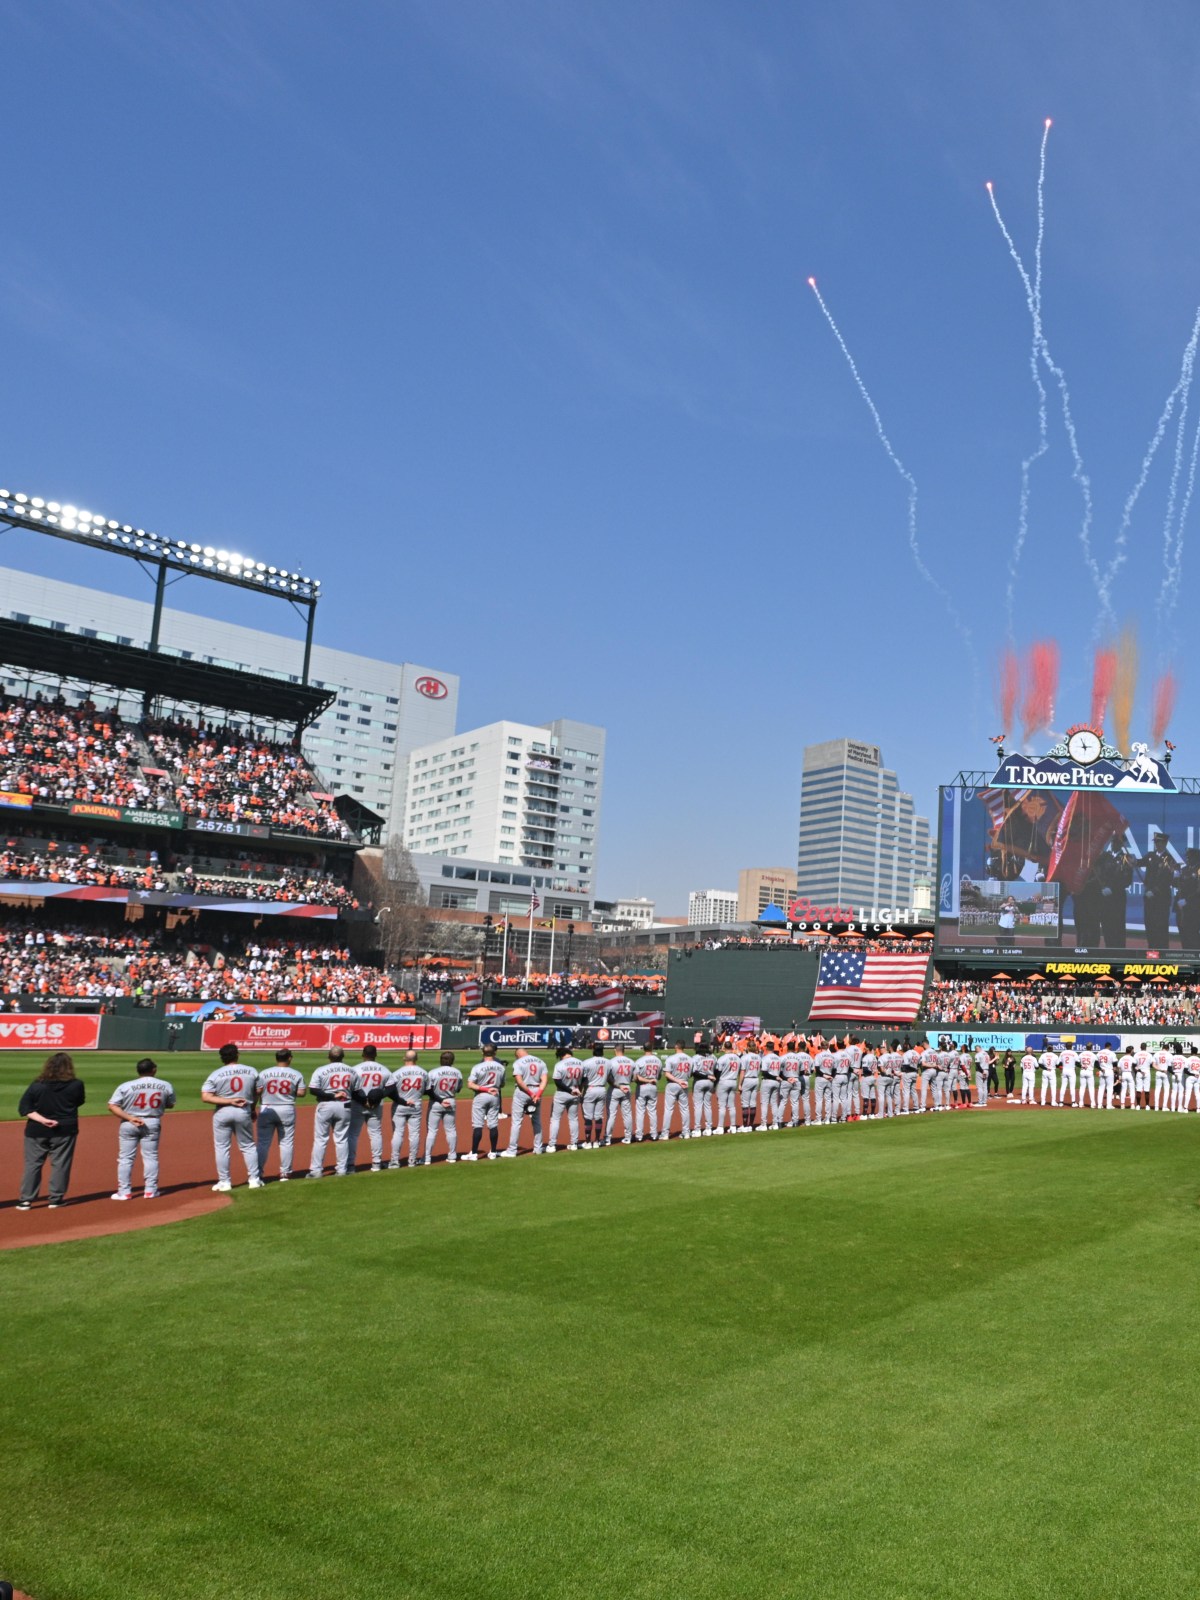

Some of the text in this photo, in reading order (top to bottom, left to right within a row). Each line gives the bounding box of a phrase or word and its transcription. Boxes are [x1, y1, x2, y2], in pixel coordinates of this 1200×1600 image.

[1071, 768, 1114, 786] Price
[74, 803, 119, 818] POMPEIAN
[125, 810, 168, 821] AMERICA'S
[132, 816, 171, 827] OLIVE OIL
[195, 820, 241, 834] 2:57:51
[788, 898, 922, 924] Coors LIGHT
[1045, 963, 1178, 975] PUREWAGER PAVILION
[295, 1006, 375, 1017] BIRD BATH
[248, 1026, 290, 1038] Airtemp
[490, 1030, 541, 1043] CareFirst
[611, 1030, 635, 1040] PNC
[22, 1037, 63, 1045] markets
[991, 1035, 1013, 1045] Price
[840, 1059, 849, 1068] 20
[1065, 1056, 1069, 1064] 2
[1082, 1057, 1090, 1065] 25
[1099, 1055, 1107, 1063] 29
[1138, 1057, 1145, 1065] 17
[529, 1064, 537, 1076] 9
[597, 1065, 604, 1077] 4
[616, 1065, 631, 1076] 43
[646, 1065, 658, 1075] 55
[677, 1062, 690, 1072] 48
[703, 1060, 714, 1071] 57
[749, 1061, 760, 1071] 54
[770, 1061, 780, 1071] 44
[786, 1061, 798, 1071] 24
[264, 1072, 296, 1080] HALLBERG
[487, 1072, 496, 1084] 2
[566, 1067, 581, 1079] 30
[230, 1077, 243, 1093] 0
[329, 1075, 350, 1089] 66
[361, 1073, 382, 1087] 79
[401, 1078, 422, 1091] 84
[439, 1078, 457, 1091] 67
[131, 1082, 166, 1091] BORREGO
[266, 1080, 292, 1095] 68
[133, 1093, 162, 1109] 46
